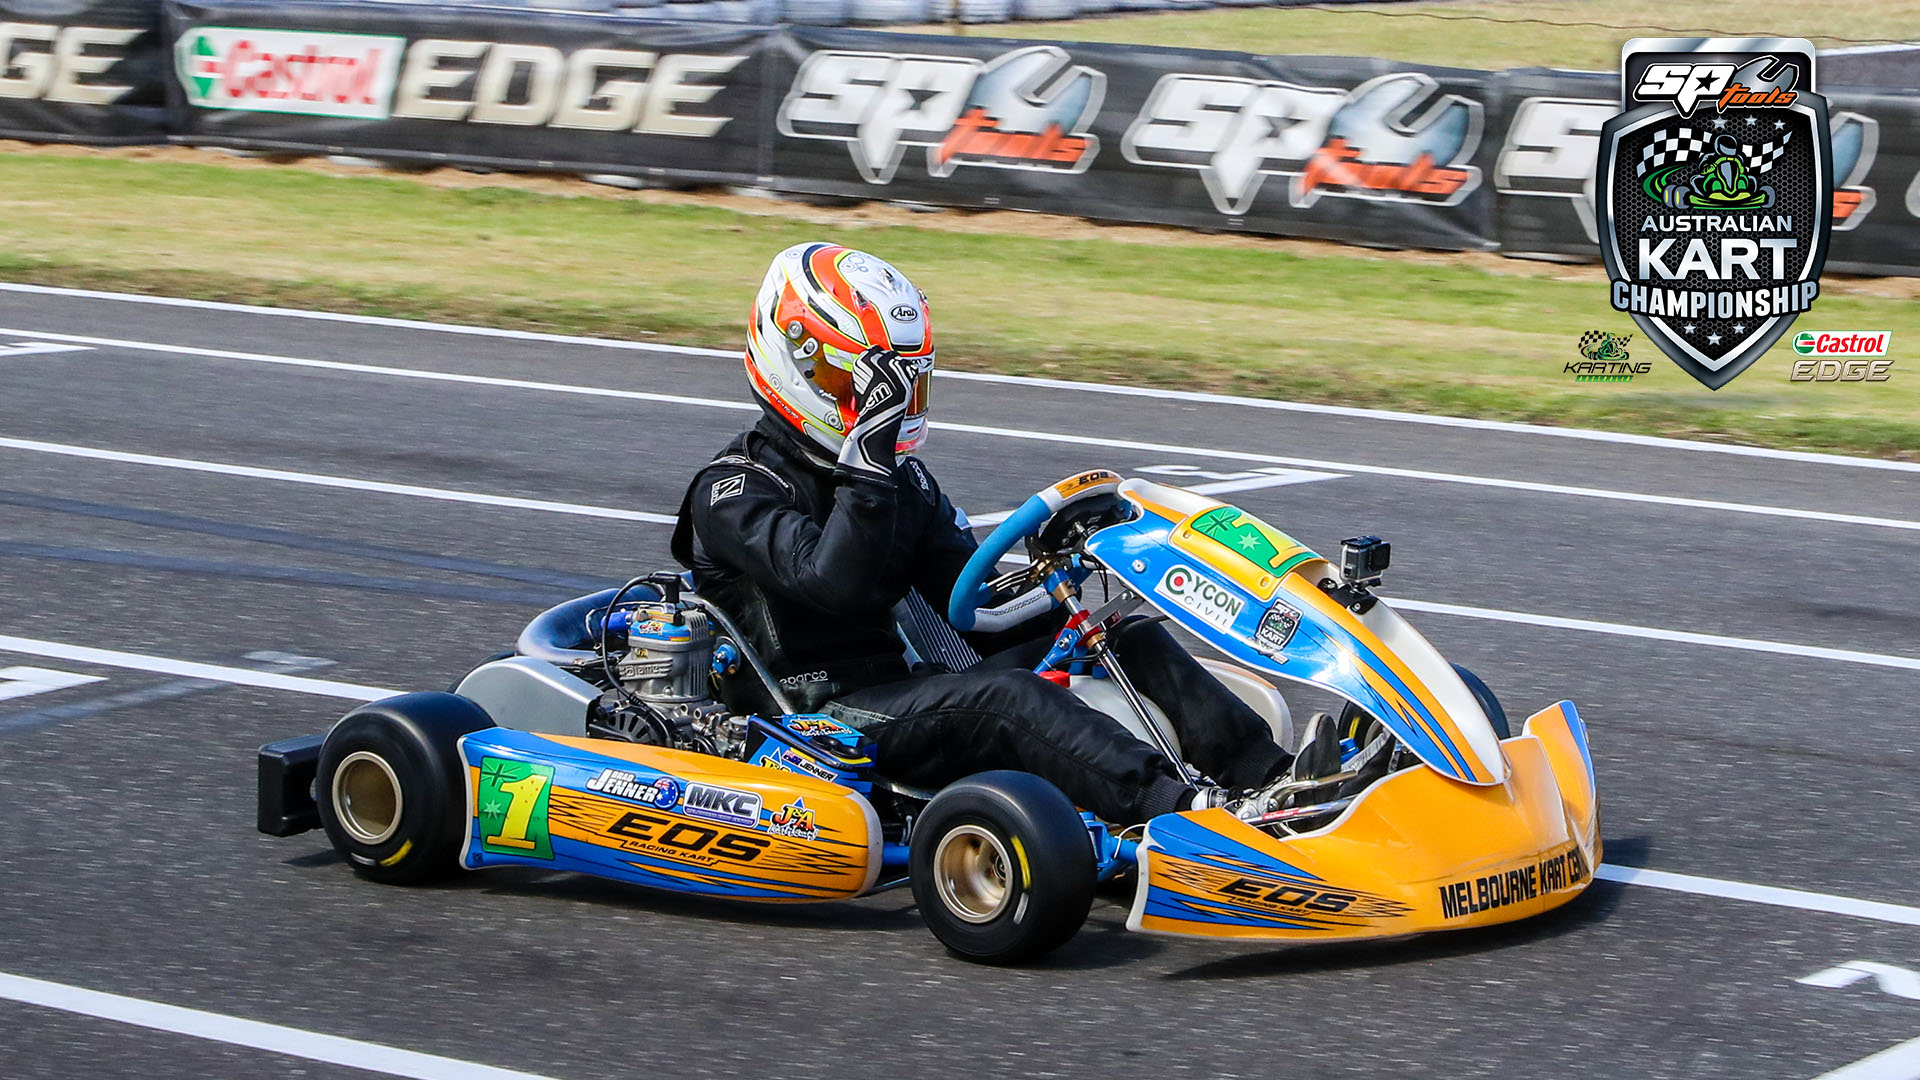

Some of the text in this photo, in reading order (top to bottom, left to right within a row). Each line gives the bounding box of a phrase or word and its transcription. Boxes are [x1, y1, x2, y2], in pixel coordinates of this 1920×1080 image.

[391, 38, 749, 138] EDGE
[783, 52, 980, 178] SP
[1127, 76, 1346, 204] SP
[1078, 471, 1108, 485] EOS
[1261, 627, 1285, 645] KART
[586, 767, 660, 804] JENNER
[800, 760, 834, 781] JENNER
[487, 773, 548, 850] 1
[686, 785, 758, 817] MKC
[607, 811, 771, 862] EOS
[629, 841, 714, 863] RACING KART
[1218, 877, 1357, 913] EOS
[1439, 864, 1537, 919] MELBOURNE
[1539, 854, 1567, 895] KART
[1279, 904, 1310, 914] KART
